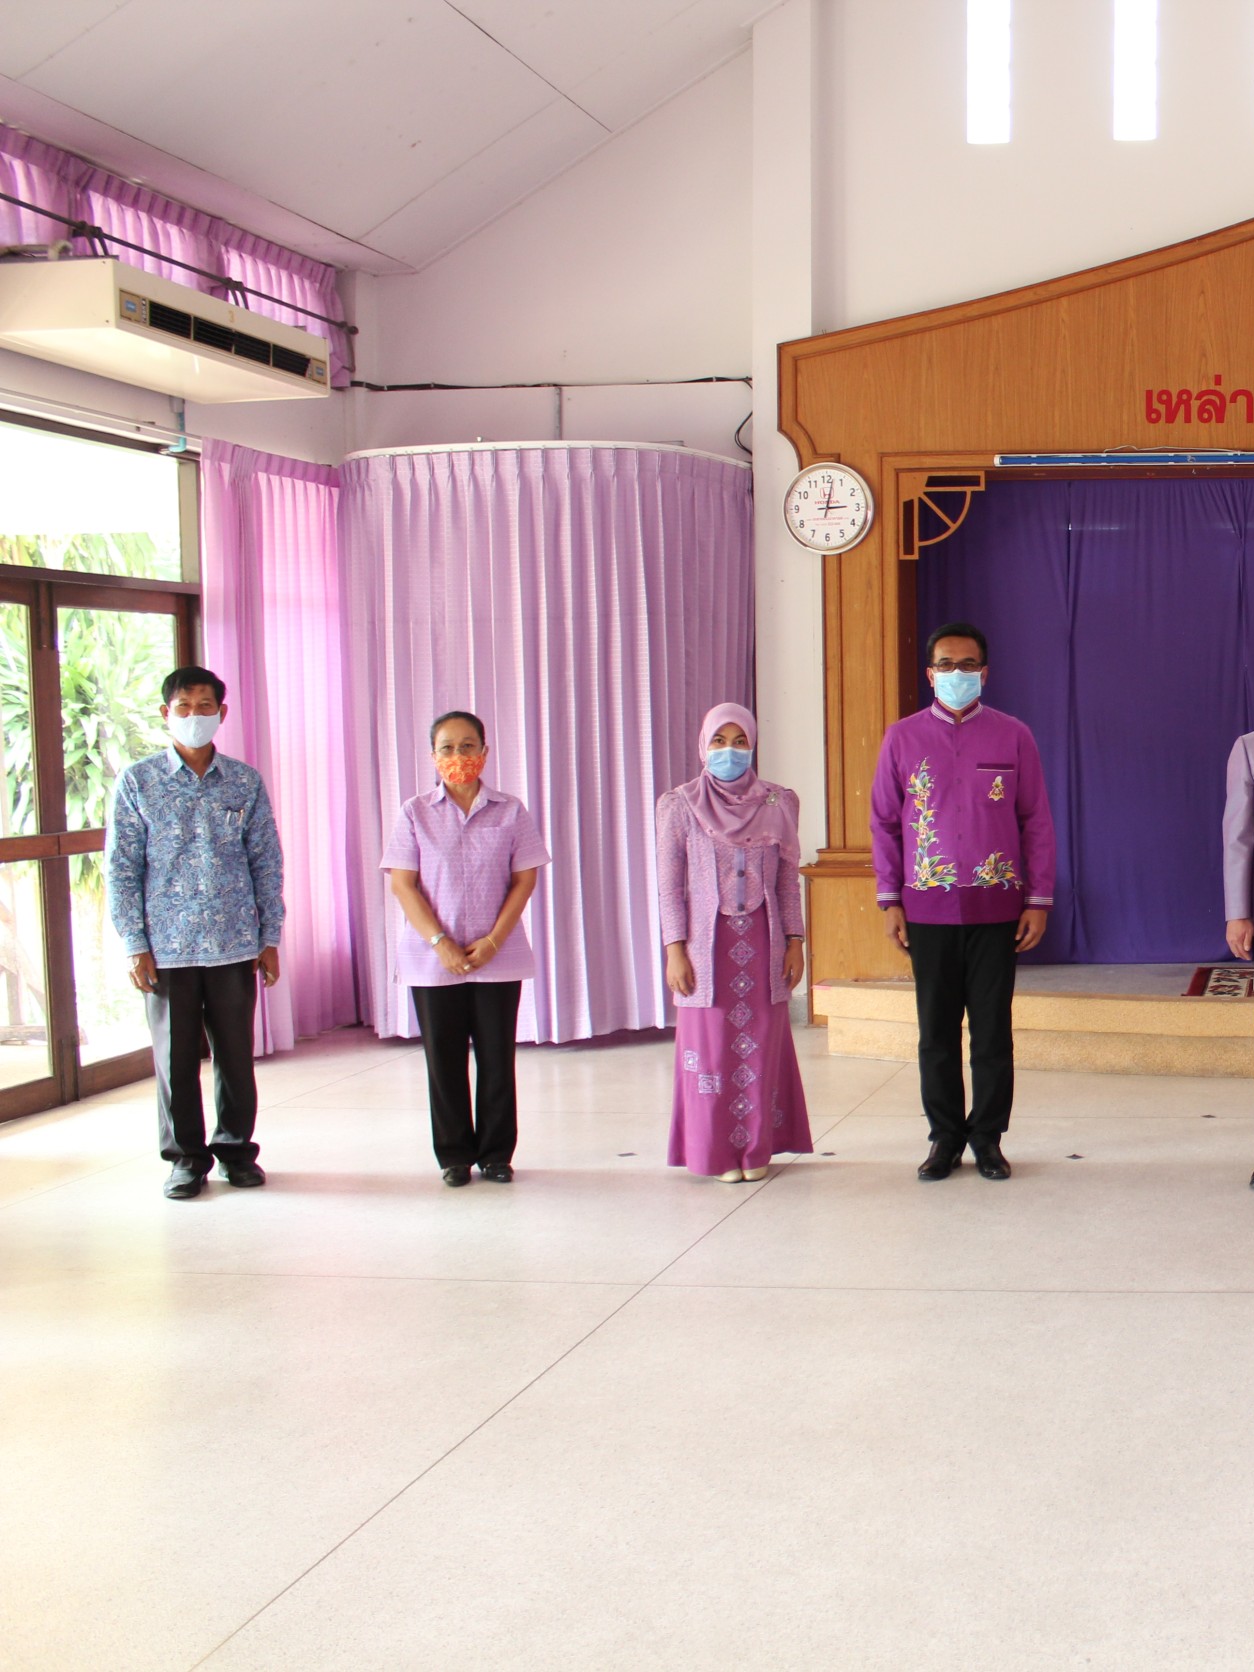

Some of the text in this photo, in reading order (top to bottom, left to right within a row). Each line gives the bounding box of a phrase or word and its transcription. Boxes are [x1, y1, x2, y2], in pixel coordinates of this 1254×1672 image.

[808, 480, 818, 488] 11
[821, 475, 832, 484] 12
[798, 491, 809, 500] 10
[850, 488, 856, 497] 2
[794, 505, 800, 514] 9
[855, 503, 861, 512] 3
[799, 520, 805, 529] 8
[850, 519, 856, 527] 4
[810, 530, 816, 538] 7
[825, 533, 831, 542] 6
[839, 529, 845, 538] 5
